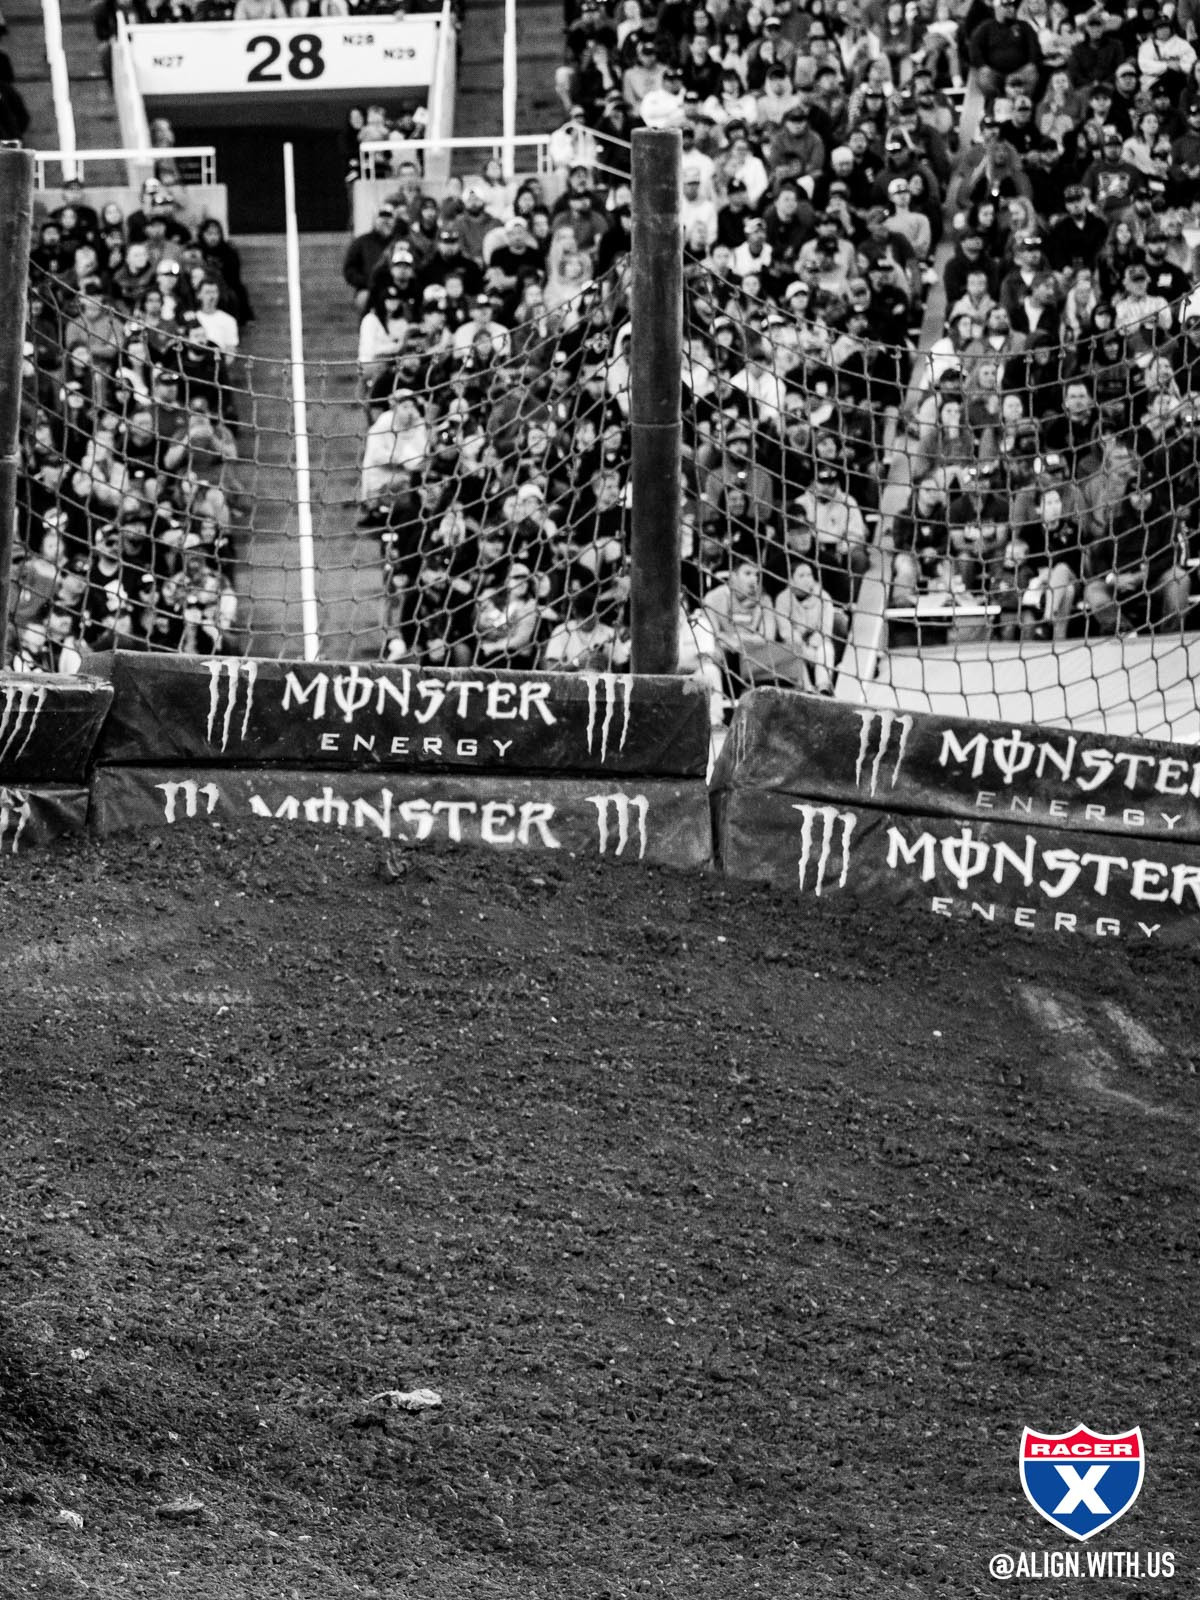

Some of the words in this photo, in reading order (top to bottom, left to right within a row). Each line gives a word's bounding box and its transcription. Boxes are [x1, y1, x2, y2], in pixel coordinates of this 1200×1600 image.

[152, 55, 184, 68] N27
[246, 34, 325, 82] 28
[281, 666, 557, 725] MONSTER
[320, 733, 513, 757] ENERGY
[975, 791, 1182, 829] ENERGY
[886, 826, 1200, 908] MONSTER
[931, 897, 1161, 938] ENERGY
